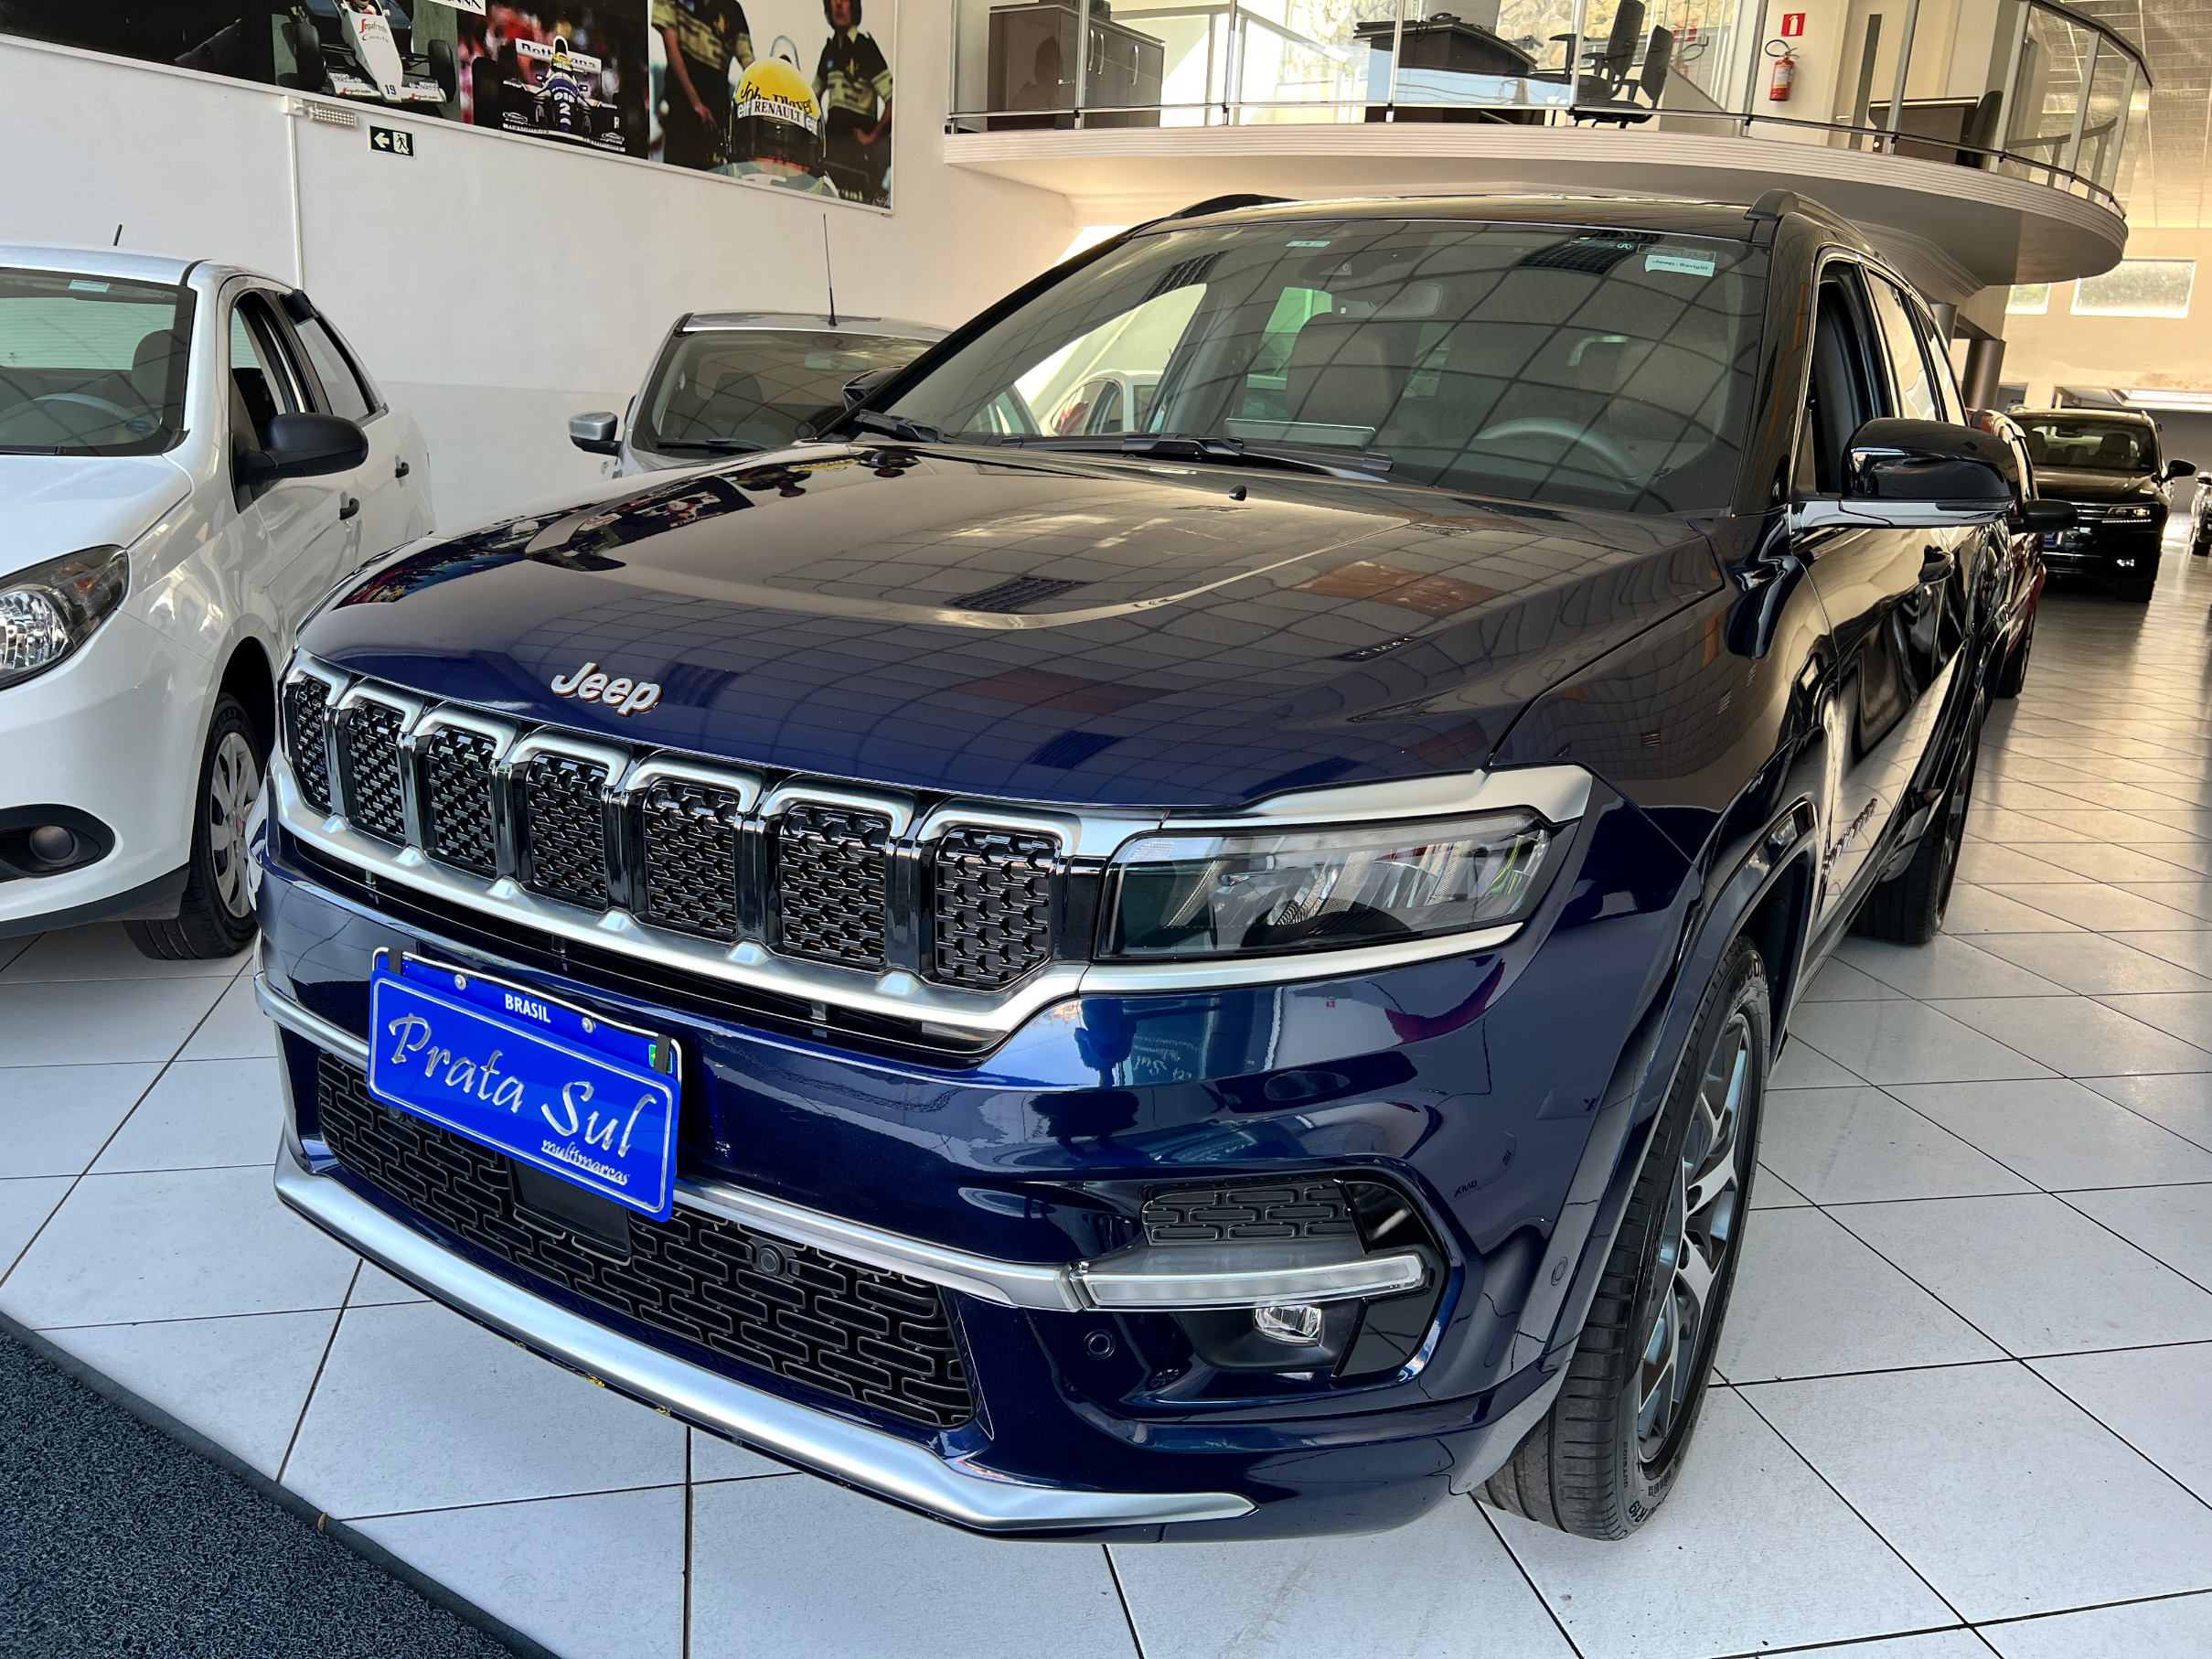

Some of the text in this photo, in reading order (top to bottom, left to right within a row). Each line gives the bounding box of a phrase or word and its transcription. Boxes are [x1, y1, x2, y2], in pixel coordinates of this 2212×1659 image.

[384, 84, 396, 96] 19
[753, 101, 802, 123] RENAULT
[550, 661, 663, 718] Jeep
[504, 993, 551, 1023] BRASIL
[388, 1012, 657, 1158] Prata Sul
[540, 1140, 630, 1186] multimarcas
